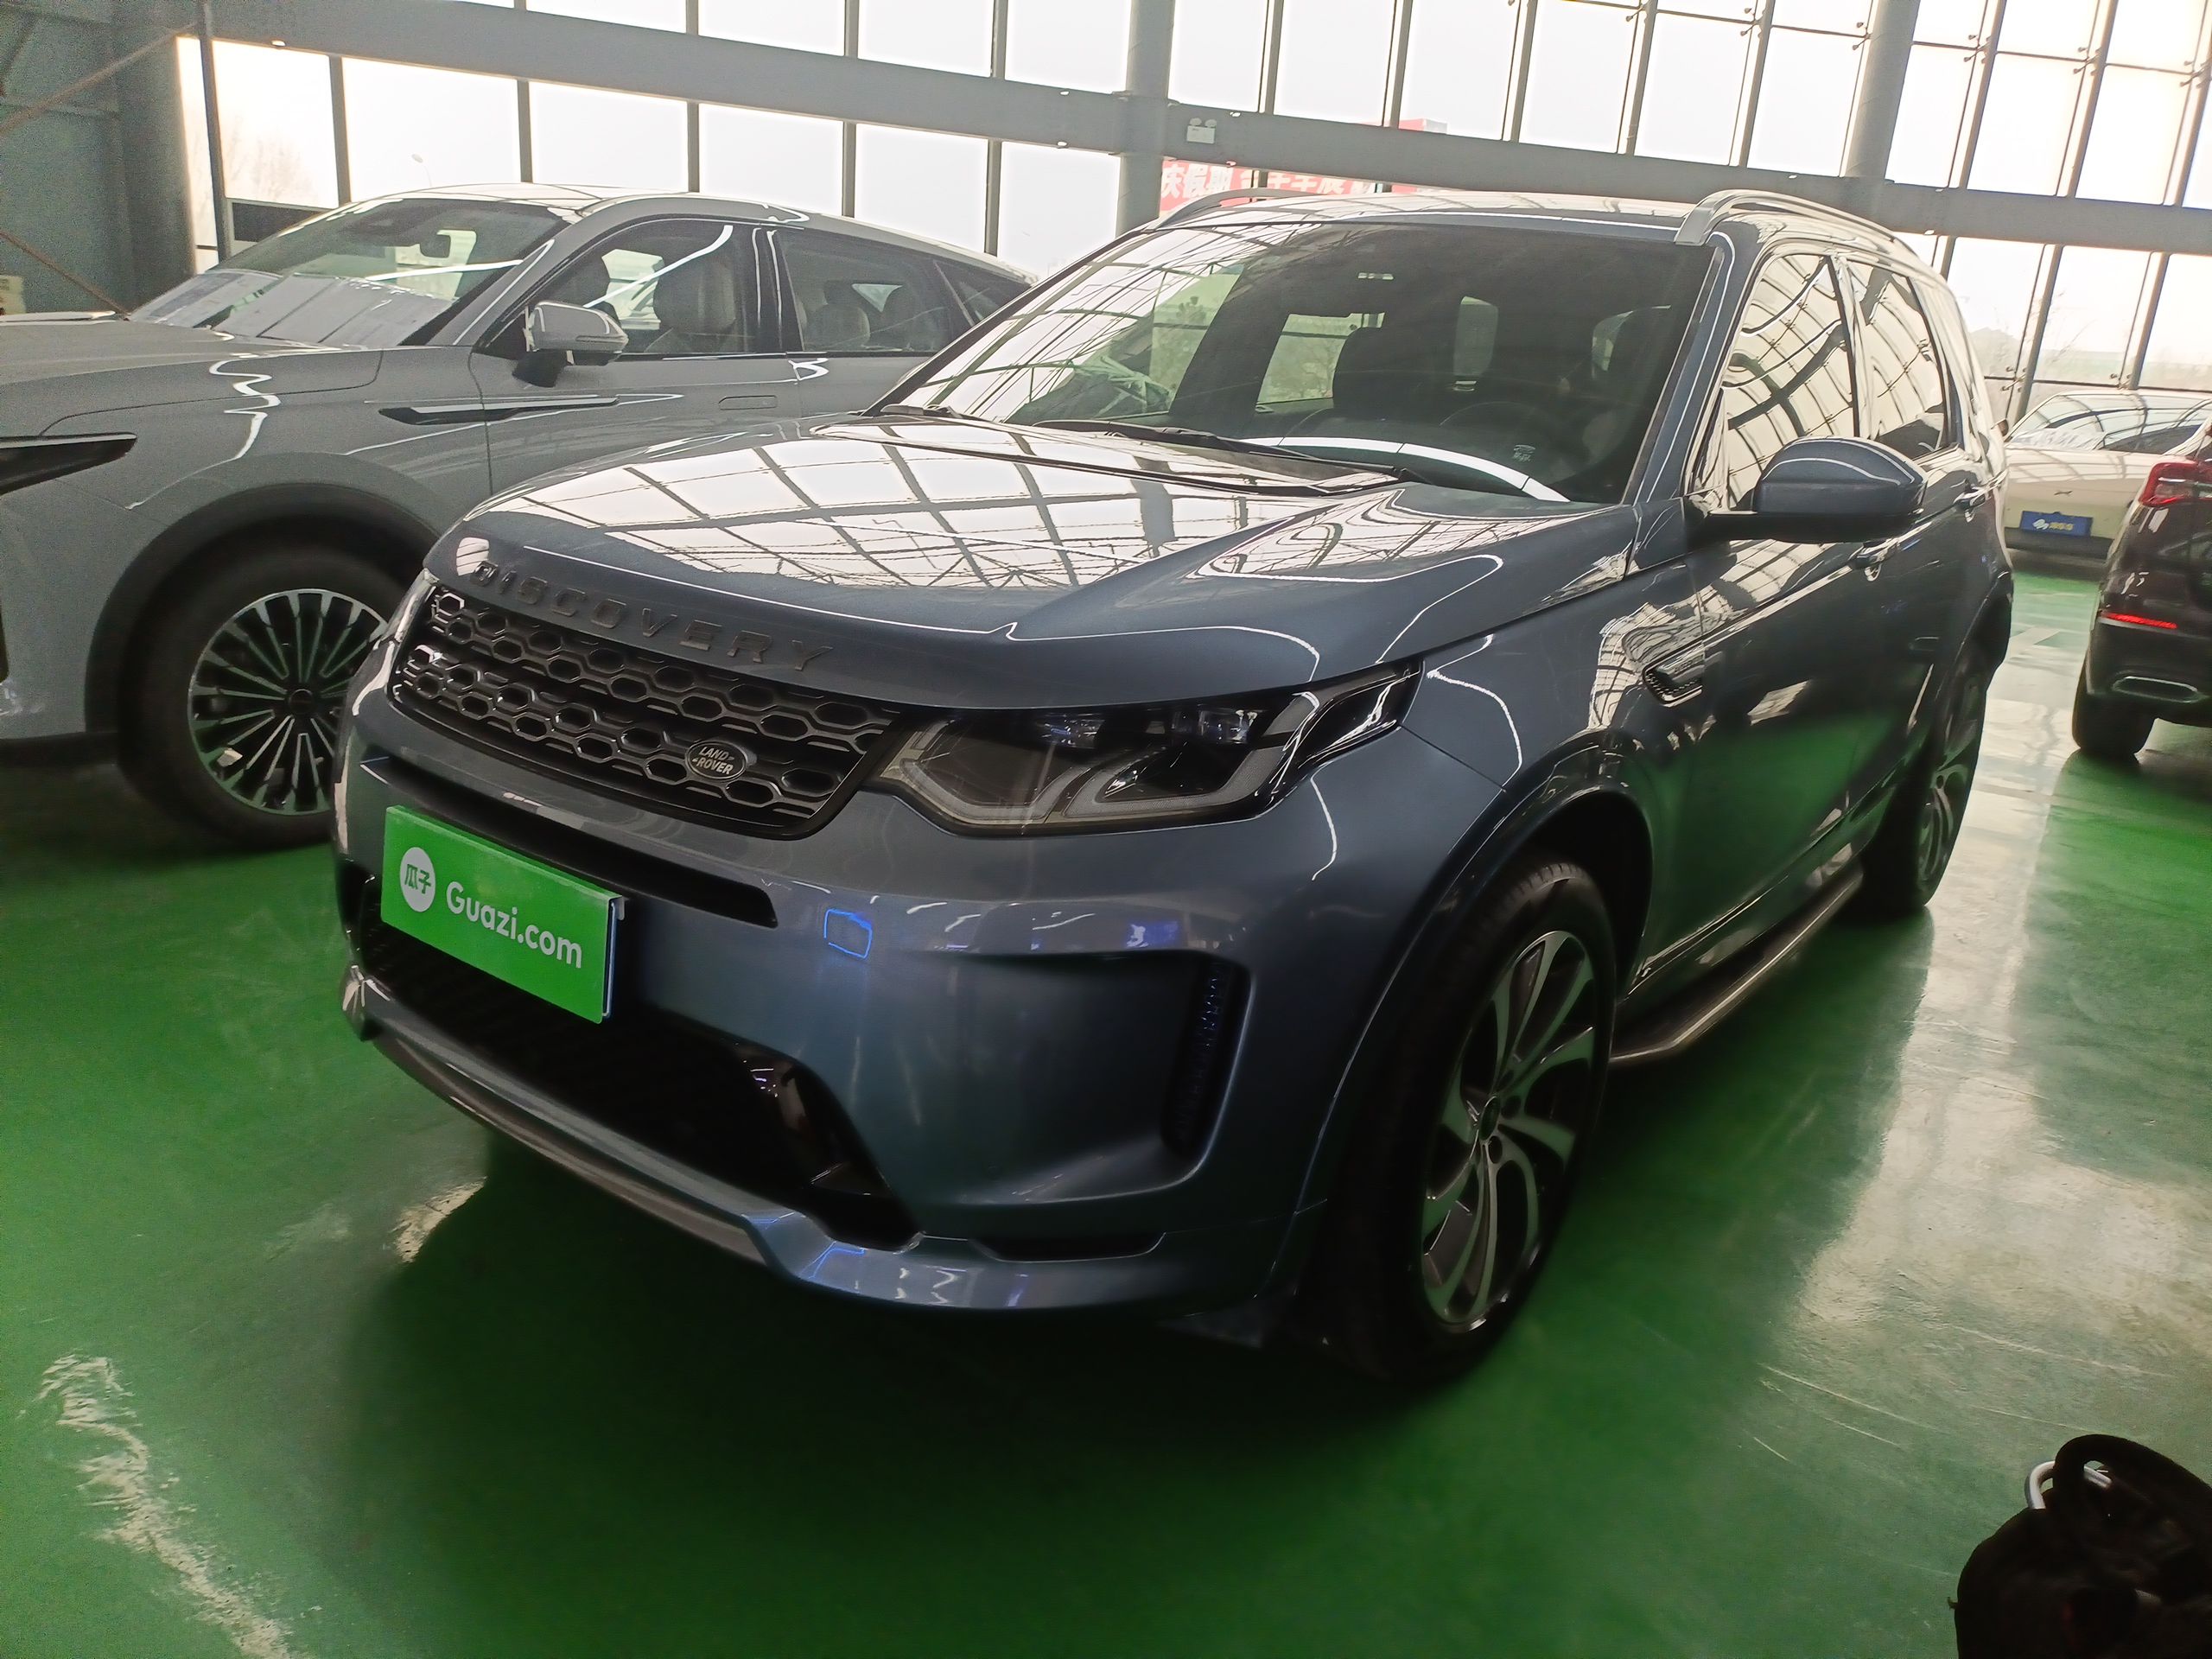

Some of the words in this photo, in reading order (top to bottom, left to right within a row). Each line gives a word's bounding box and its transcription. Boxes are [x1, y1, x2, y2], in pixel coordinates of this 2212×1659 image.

[469, 559, 834, 671] DISCOVERY
[696, 757, 734, 775] ROVER
[698, 746, 729, 761] LAND
[404, 863, 432, 894] 瓜子
[446, 880, 582, 969] Guazi.com
